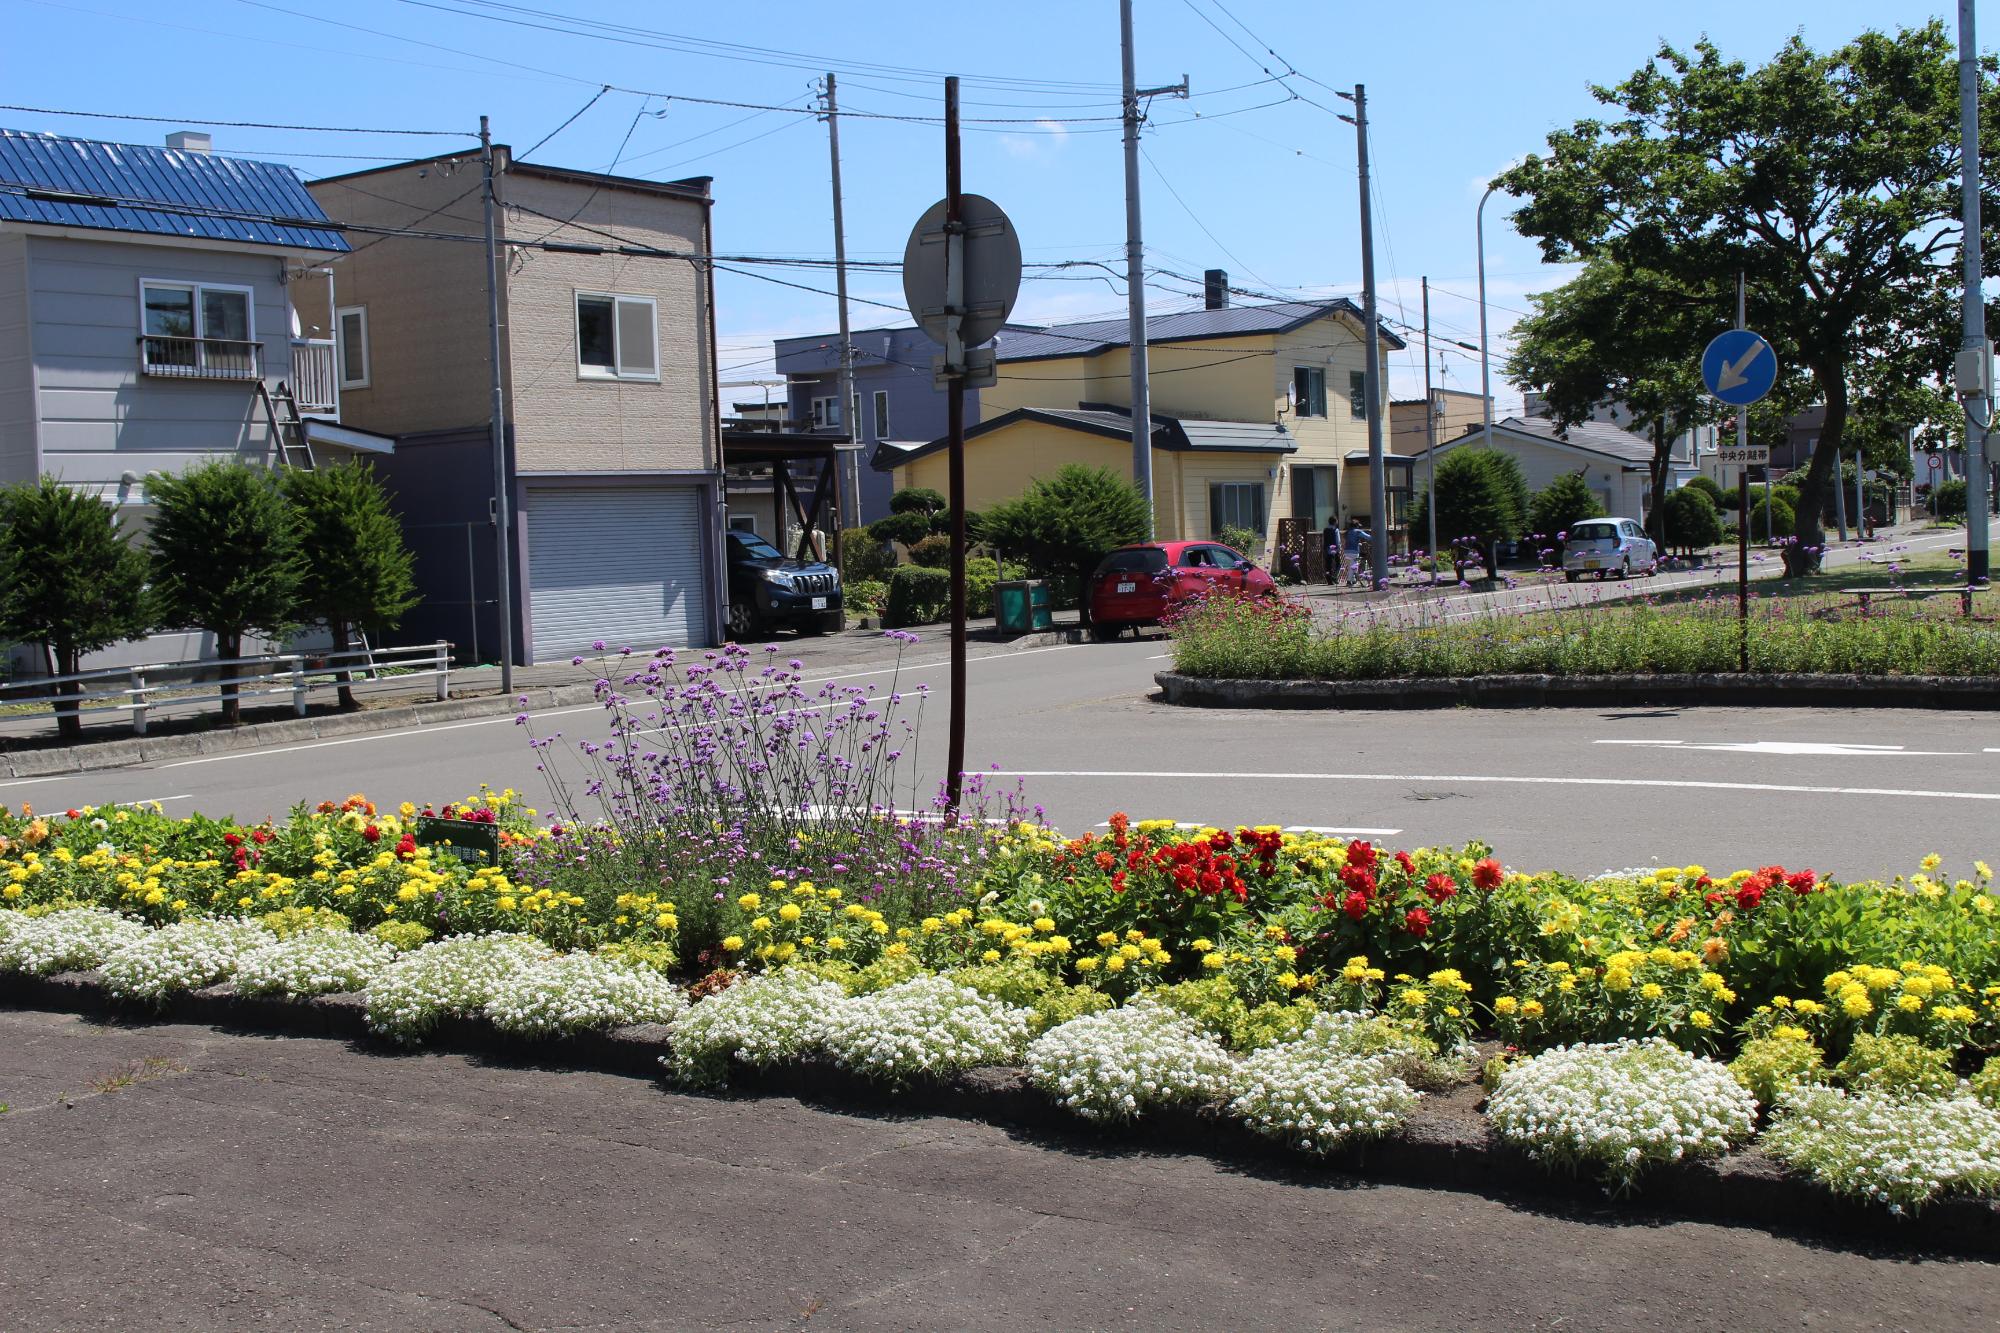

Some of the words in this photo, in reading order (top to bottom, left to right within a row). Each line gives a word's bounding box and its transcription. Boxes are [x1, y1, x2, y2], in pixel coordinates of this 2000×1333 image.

[1719, 449, 1768, 461] 中央分離帯
